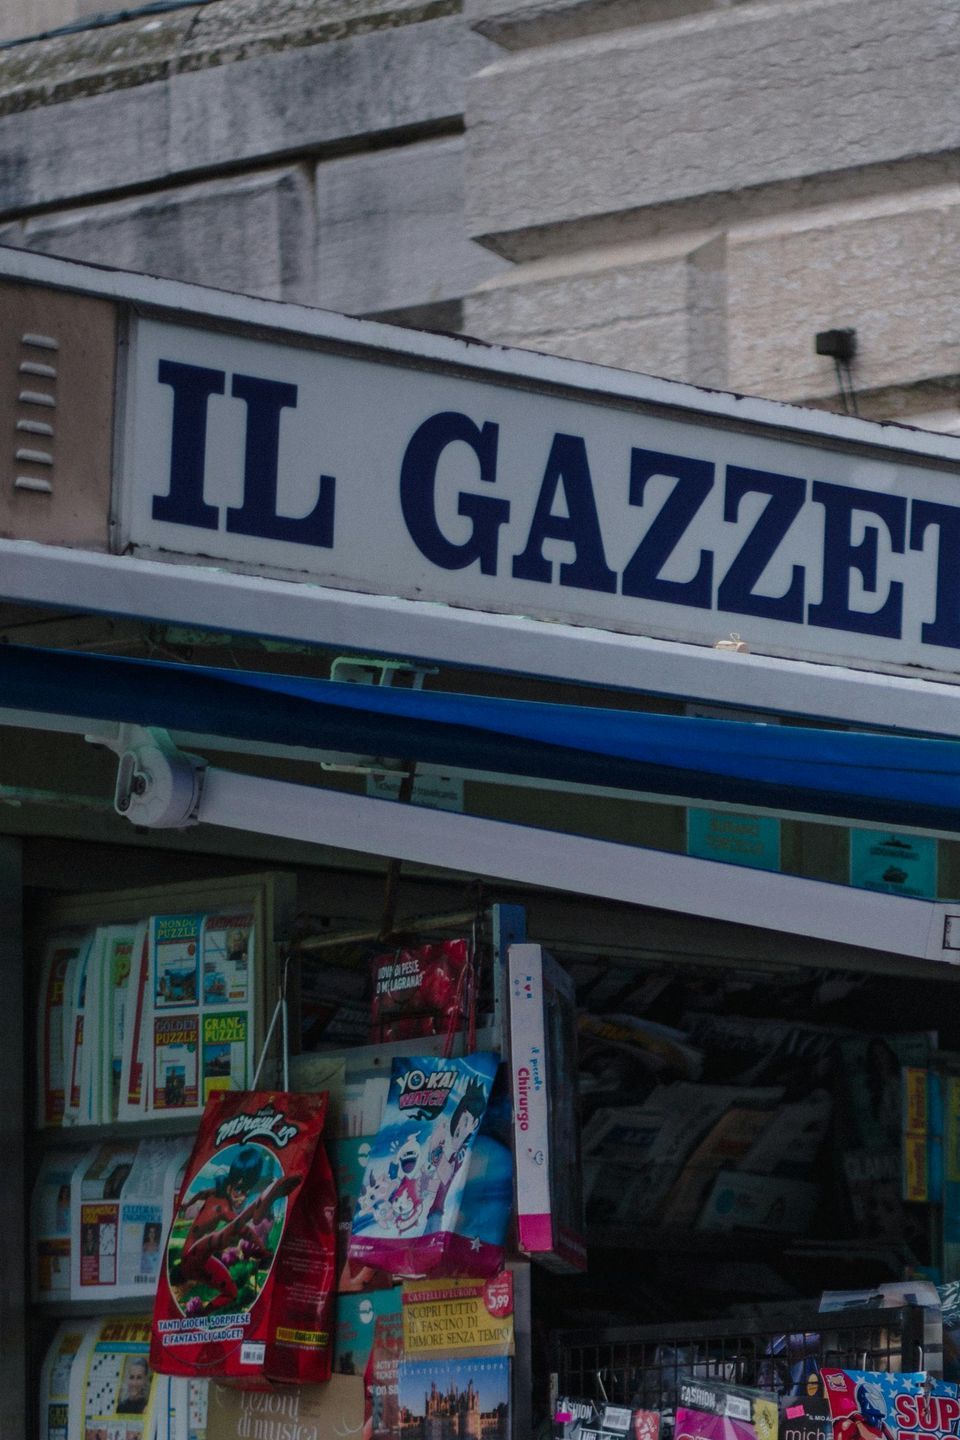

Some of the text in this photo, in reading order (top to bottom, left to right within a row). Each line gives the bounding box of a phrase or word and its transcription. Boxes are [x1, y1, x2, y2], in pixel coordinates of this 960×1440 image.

[152, 359, 335, 548] IL
[158, 927, 197, 939] PUZZLE
[160, 919, 196, 929] MONDO
[156, 1031, 197, 1045] PUZZLE
[204, 1029, 246, 1044] PUZZLE
[399, 1090, 452, 1108] WATCH
[517, 1067, 530, 1131] Chirurgo
[408, 1301, 478, 1320] SCOPRI TUTTO
[158, 1318, 180, 1332] TANTI
[211, 1311, 251, 1327] SORPRESE
[421, 1318, 464, 1332] FASCINO
[467, 1315, 478, 1327] DI
[171, 1331, 212, 1345] FANTASTICI
[212, 1327, 244, 1343] GADGET!
[408, 1333, 444, 1348] DIMORE
[446, 1331, 475, 1345] SENZA
[681, 1385, 715, 1409] FASHION
[237, 1410, 252, 1438] di
